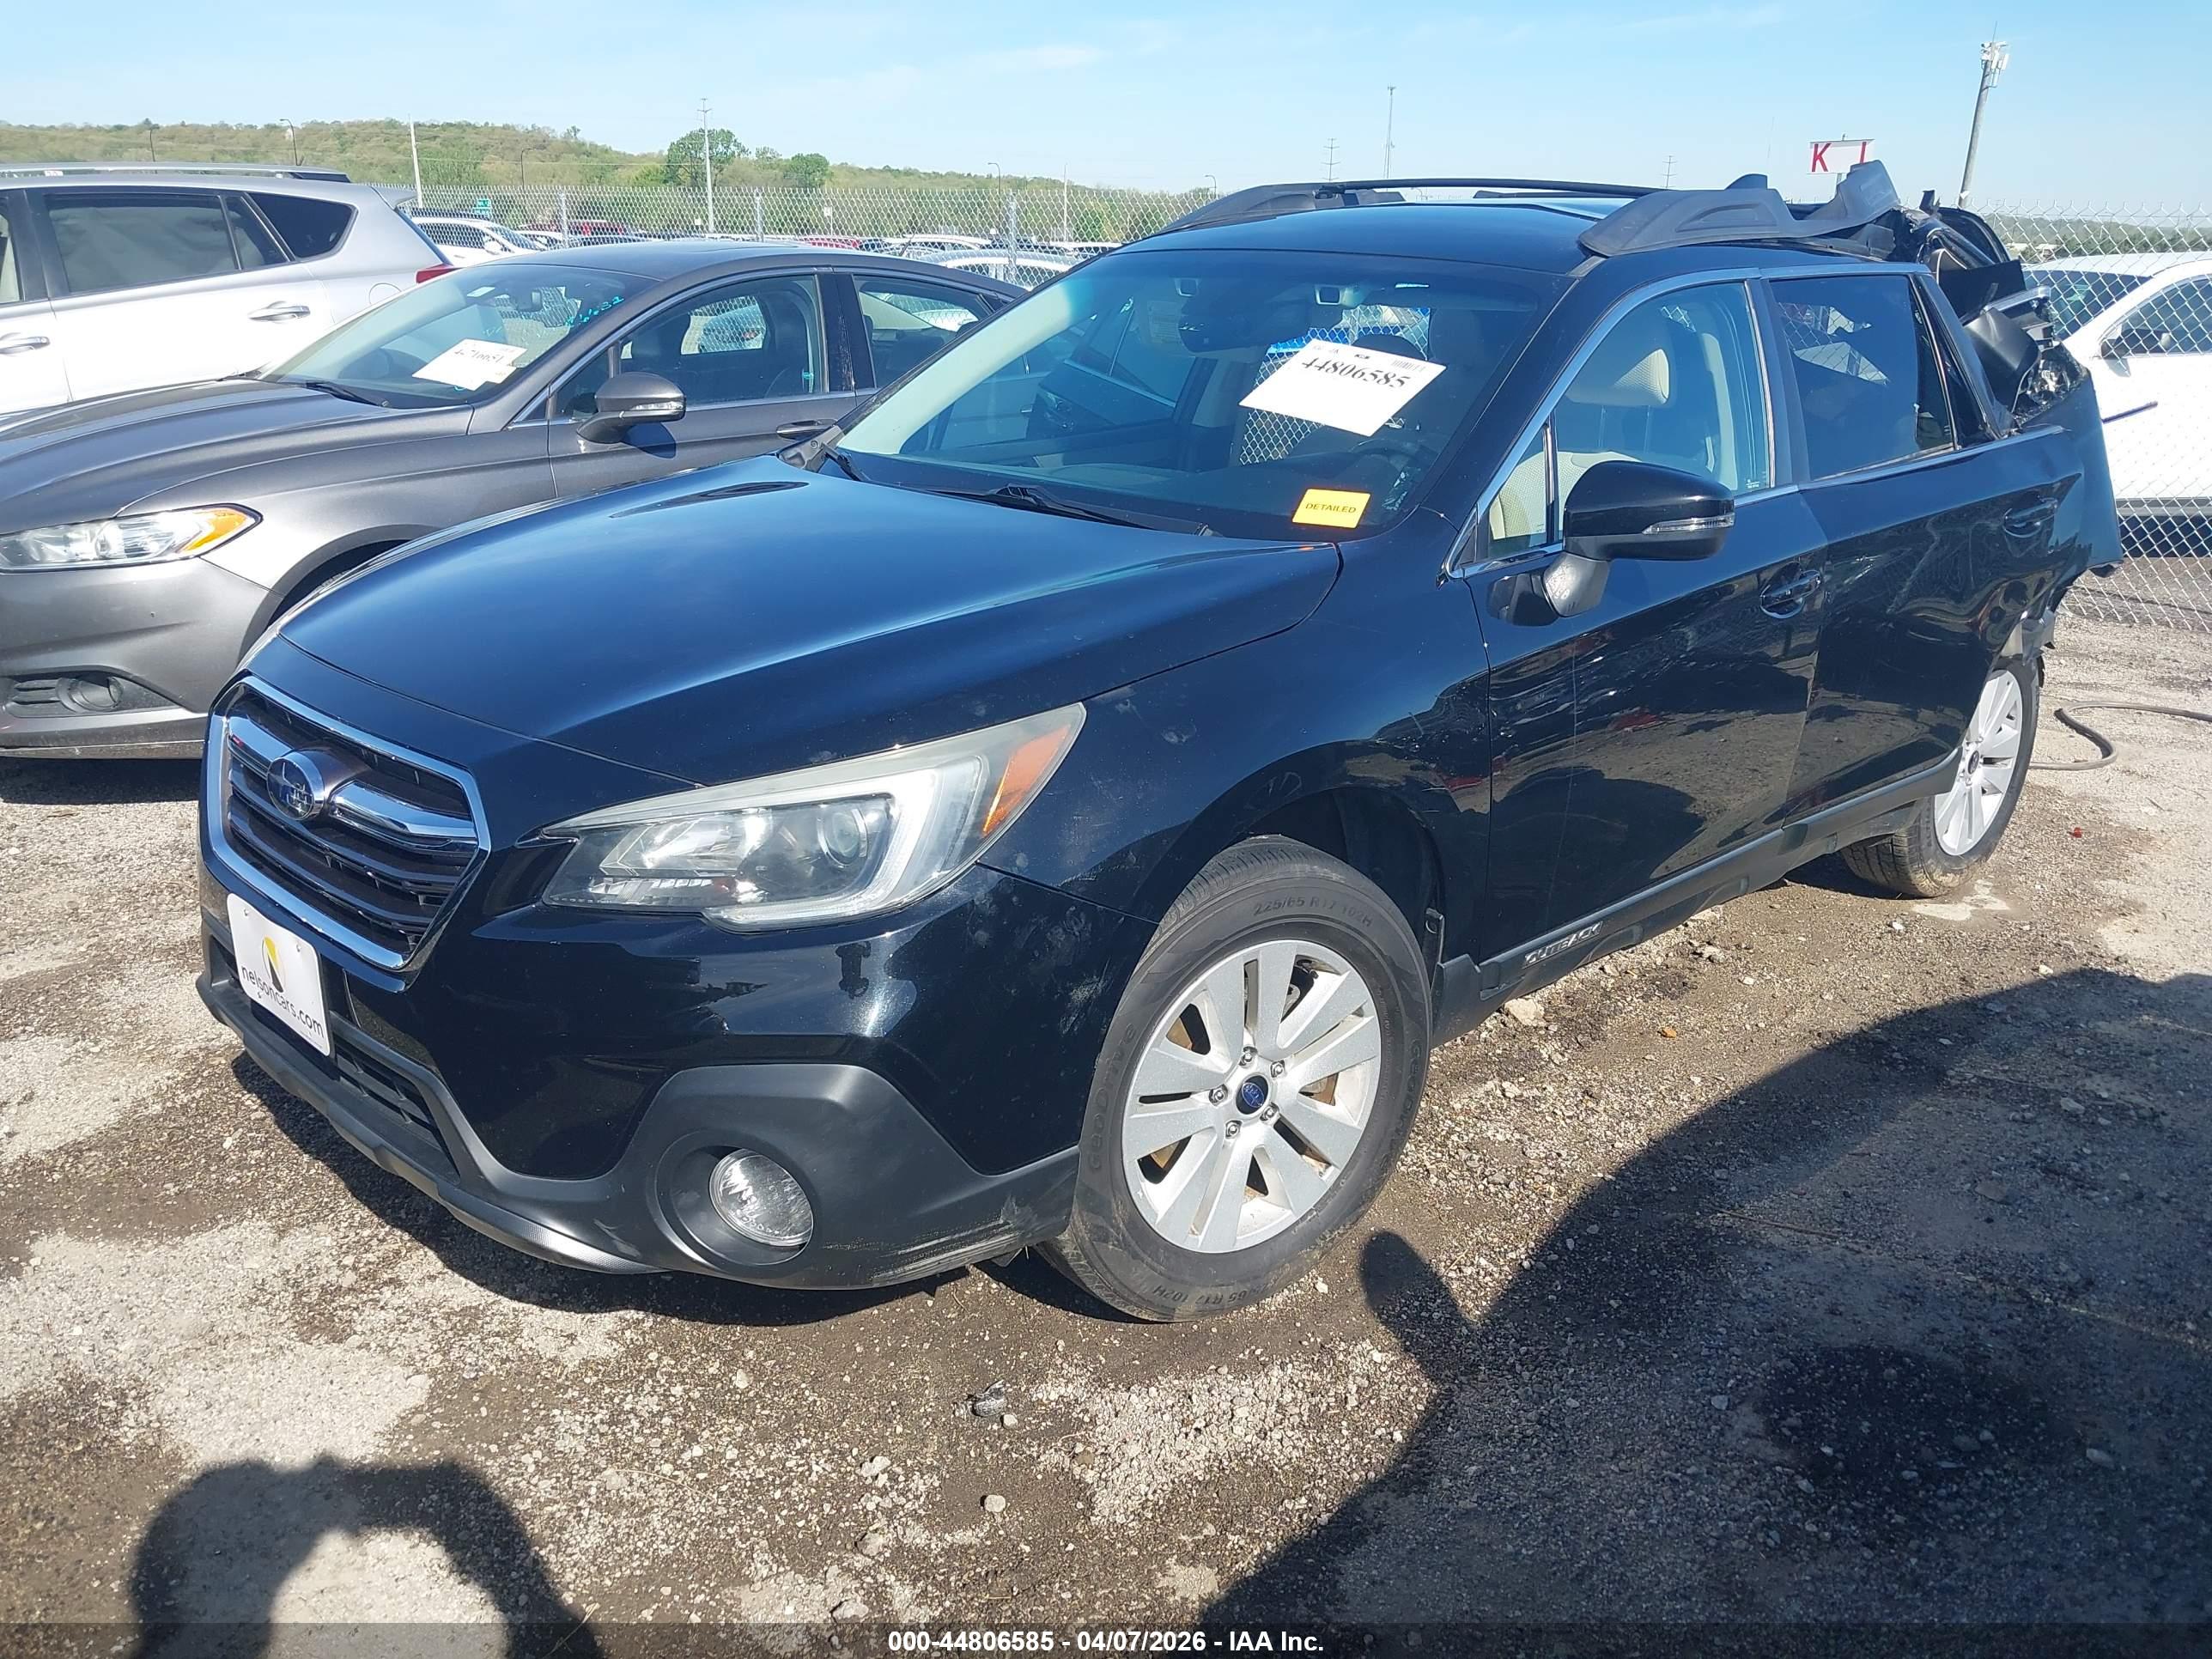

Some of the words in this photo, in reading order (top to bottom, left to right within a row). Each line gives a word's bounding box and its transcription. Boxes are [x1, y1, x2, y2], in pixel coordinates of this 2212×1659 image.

[1811, 143, 1832, 173] K
[1302, 357, 1412, 388] 44806585
[1305, 502, 1357, 514] DETAILED
[240, 964, 325, 1039] nelsoncars.com
